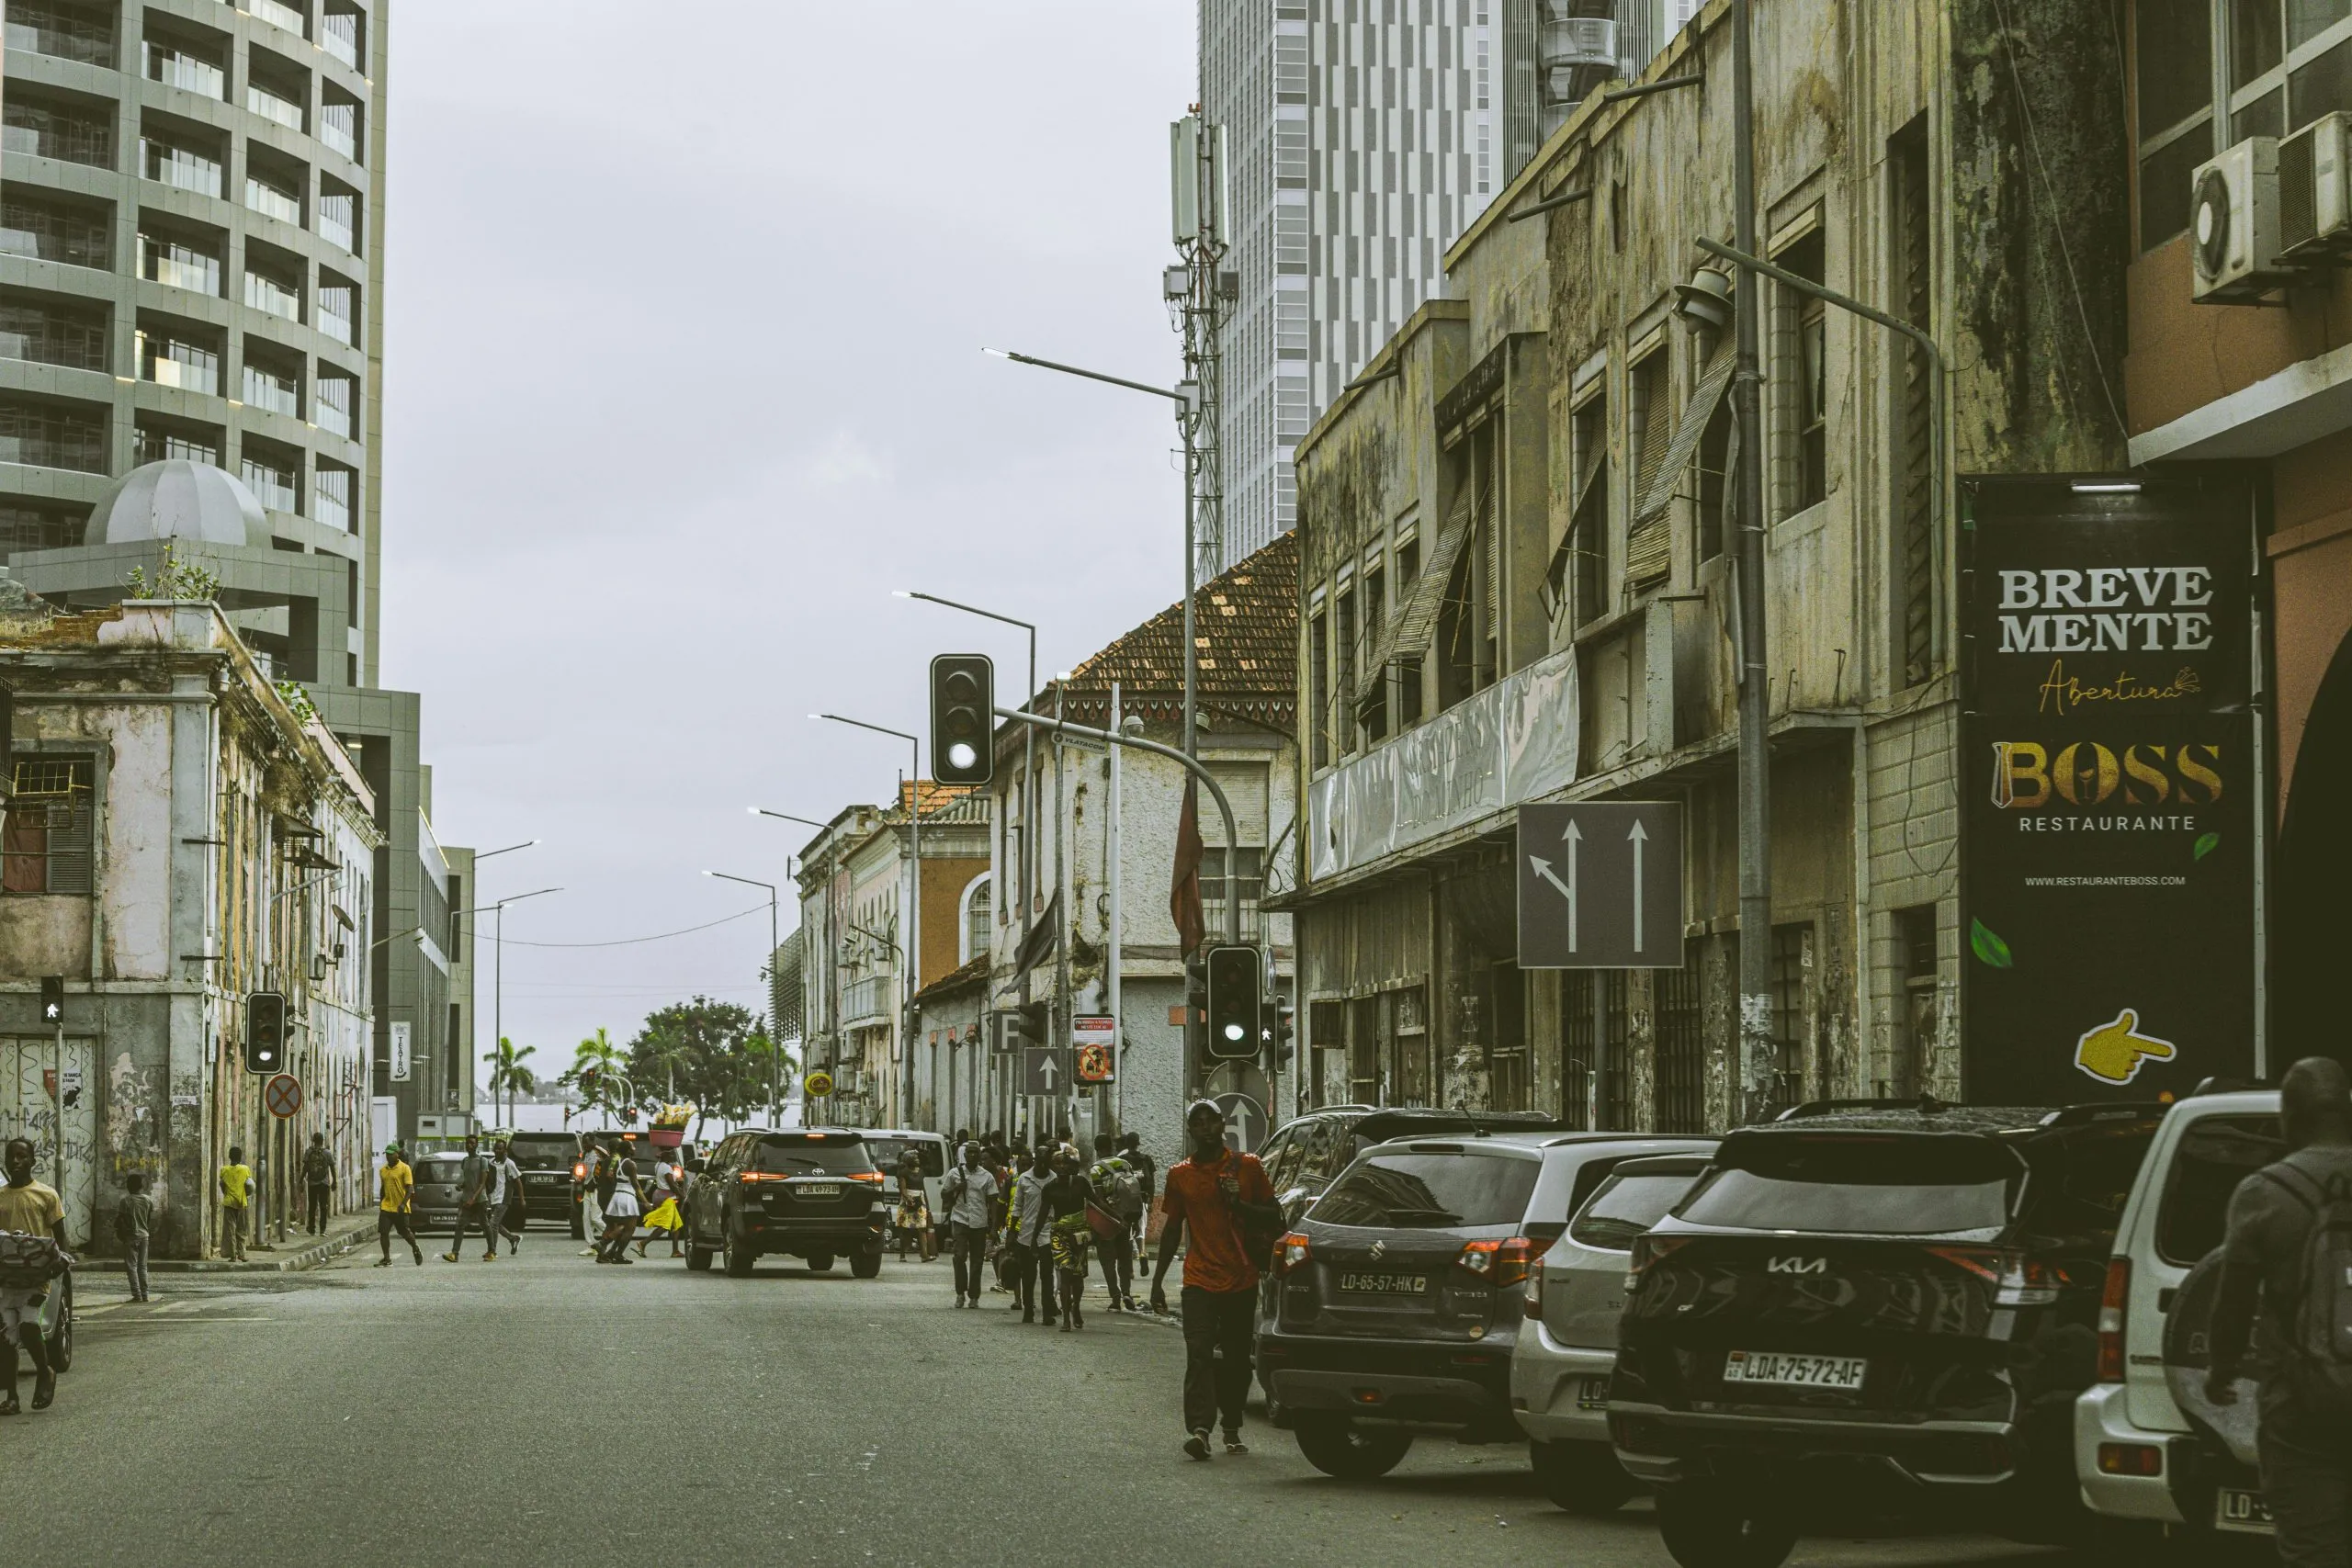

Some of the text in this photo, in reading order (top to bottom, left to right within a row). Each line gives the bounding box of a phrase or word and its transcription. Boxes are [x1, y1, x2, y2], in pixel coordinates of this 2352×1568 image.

[1998, 567, 2214, 609] BREVE
[1998, 613, 2214, 652] MENTE
[2040, 659, 2183, 716] Abertura
[1065, 738, 1105, 750] VLATACOM
[1991, 741, 2222, 808] BOSS
[2019, 817, 2195, 831] RESTAURANTE
[2025, 876, 2187, 886] WWW.RESTAURANTEBOSS.COM
[1768, 1257, 1827, 1274] KIA
[1341, 1274, 1412, 1292] LD-65-57-HK
[1745, 1354, 1864, 1385] LDA-75-72-AF
